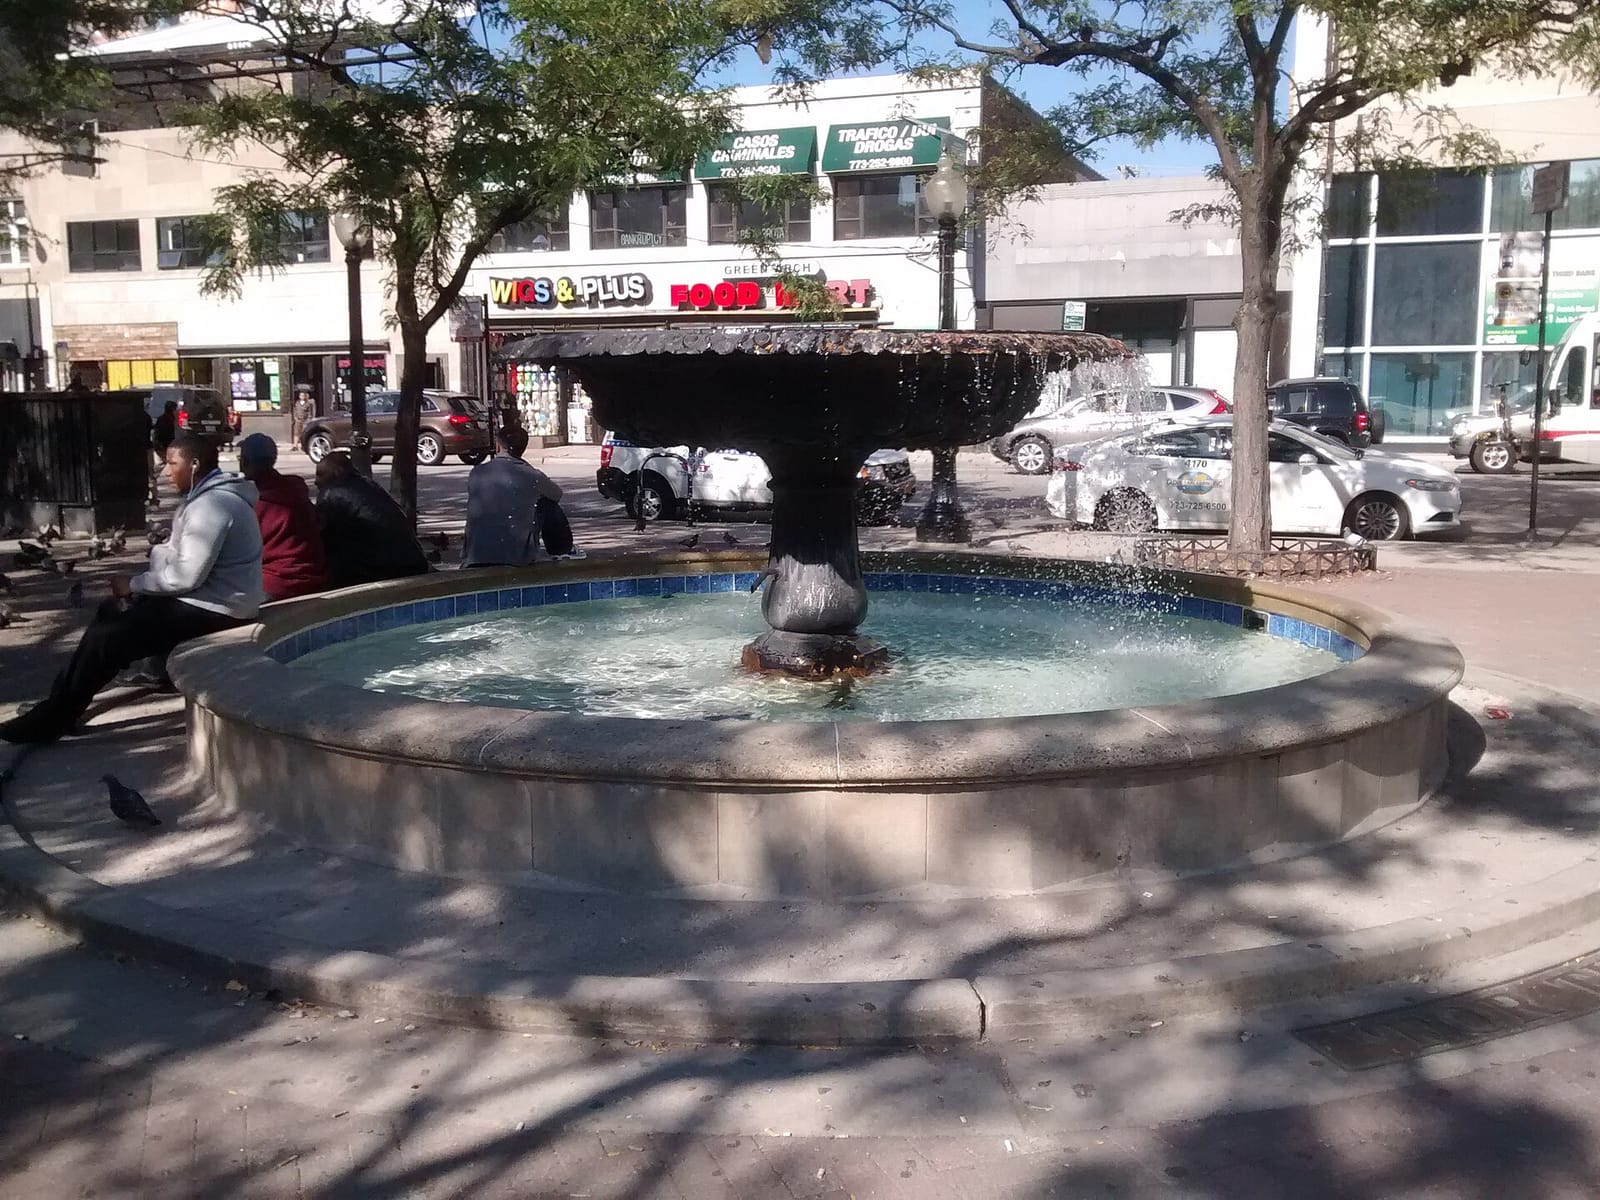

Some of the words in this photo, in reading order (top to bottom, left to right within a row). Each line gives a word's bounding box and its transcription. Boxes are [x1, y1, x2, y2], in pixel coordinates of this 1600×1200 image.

[733, 134, 780, 149] CASOS
[838, 126, 898, 142] TRAFICO
[853, 138, 915, 154] DROGAS
[724, 262, 768, 275] GREEN
[490, 278, 550, 304] WIGS
[556, 279, 574, 302] &
[582, 275, 645, 302] PLUS
[670, 281, 760, 307] FOOD
[774, 278, 870, 307] MRT
[1184, 459, 1208, 468] 4170
